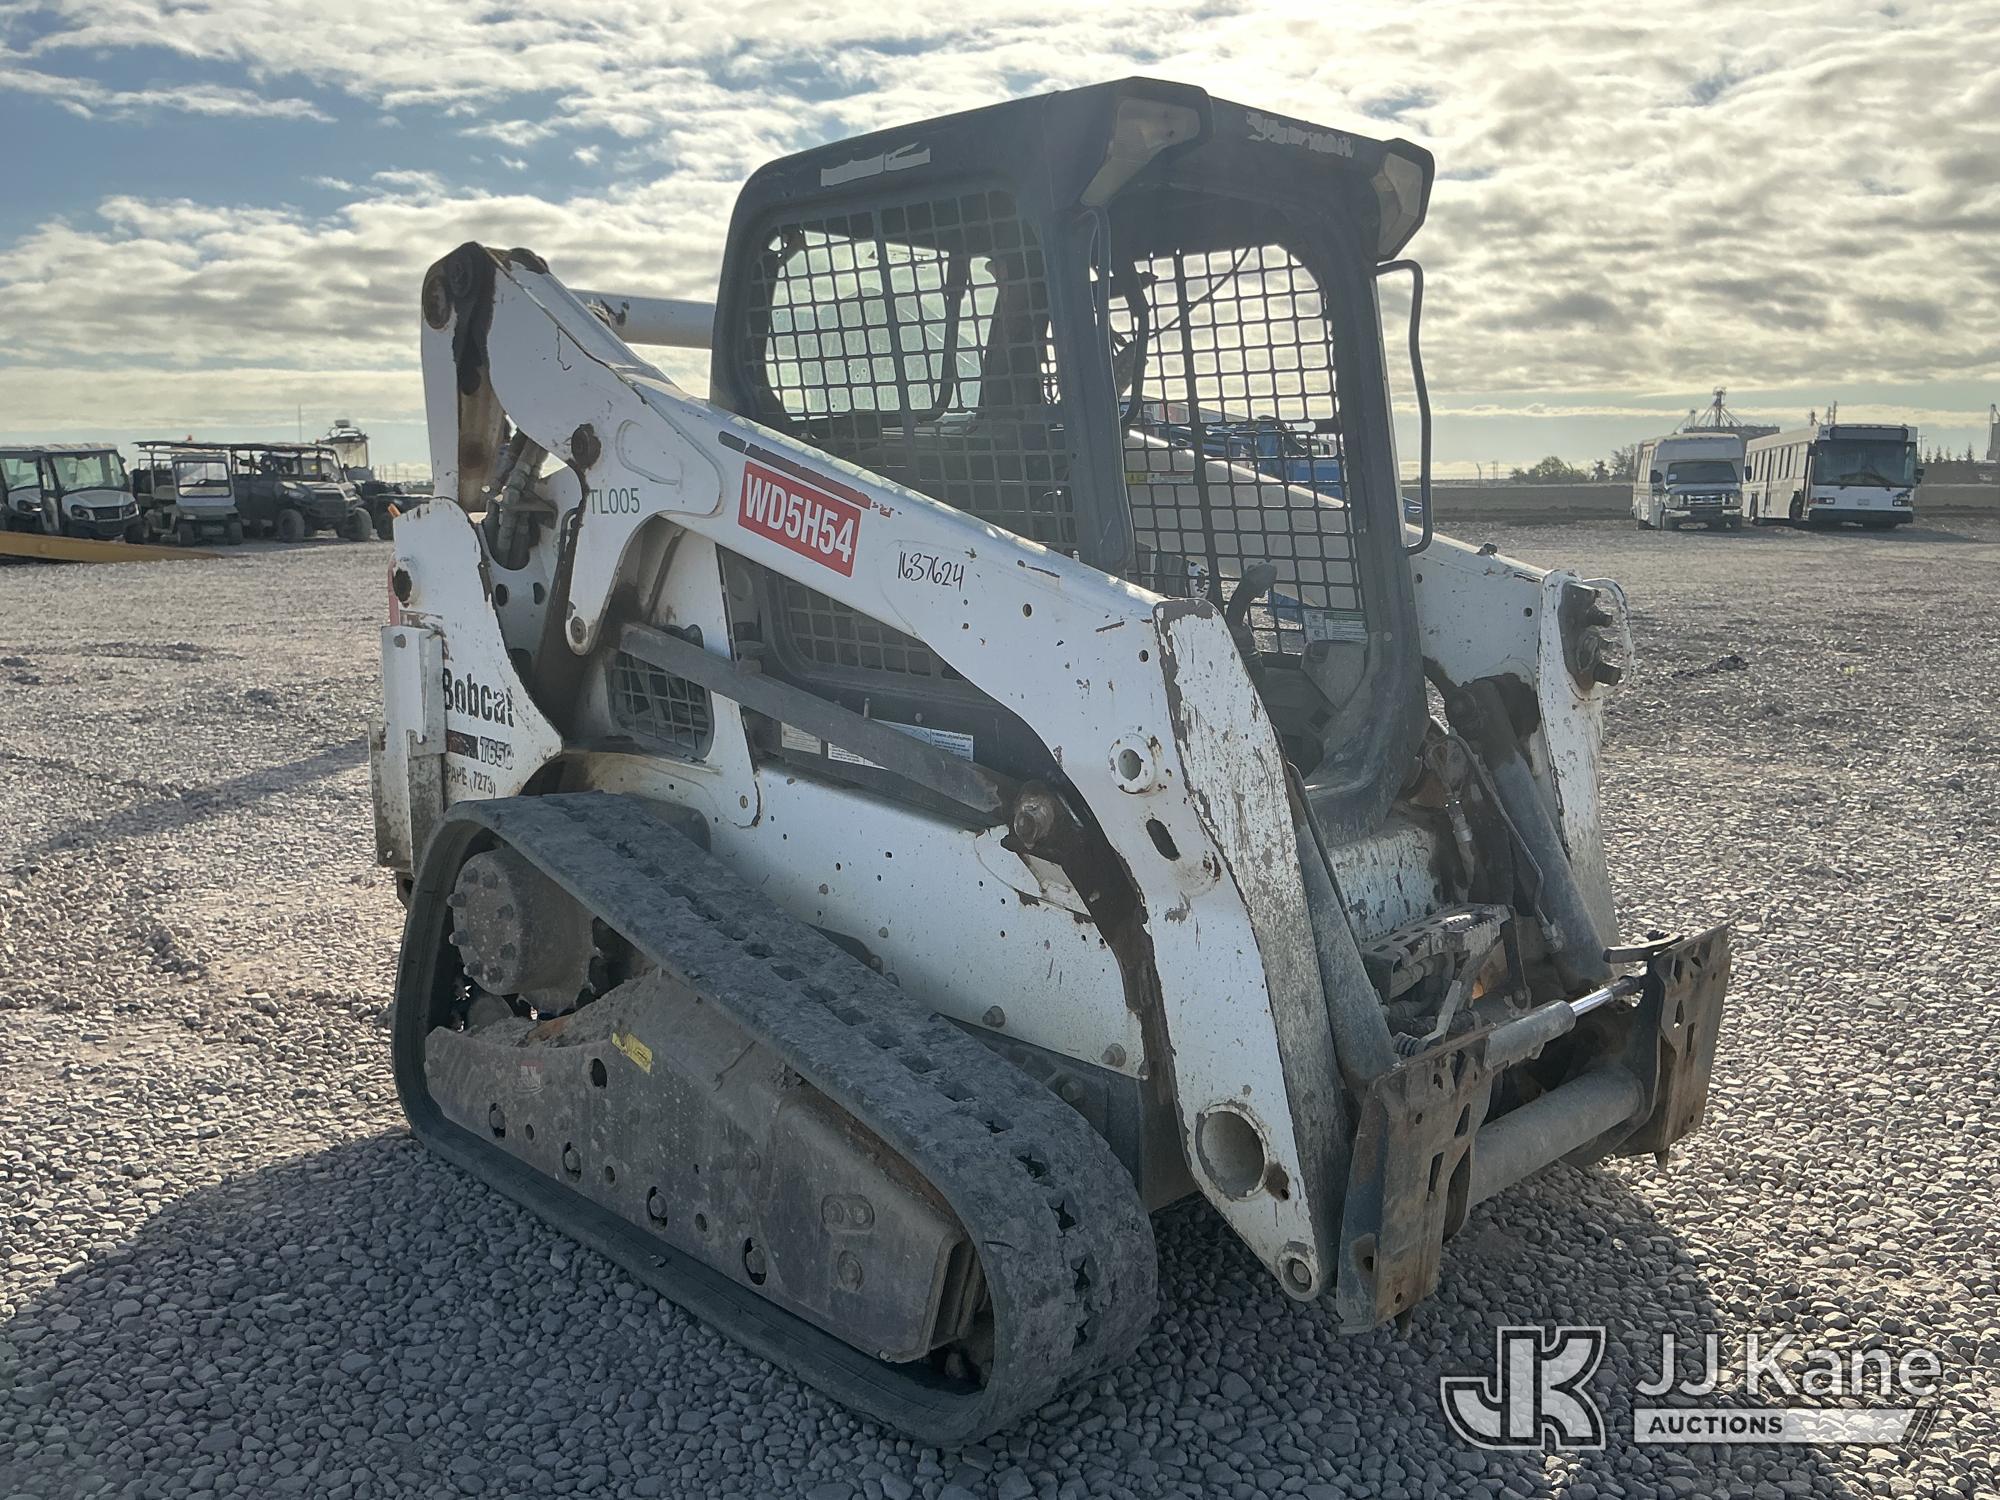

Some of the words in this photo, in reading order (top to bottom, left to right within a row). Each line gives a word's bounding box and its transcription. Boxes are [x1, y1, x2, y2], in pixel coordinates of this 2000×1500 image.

[589, 487, 640, 515] TL005
[745, 473, 855, 564] WD5H54
[897, 551, 965, 592] 1637624
[442, 667, 514, 728] Bobcat
